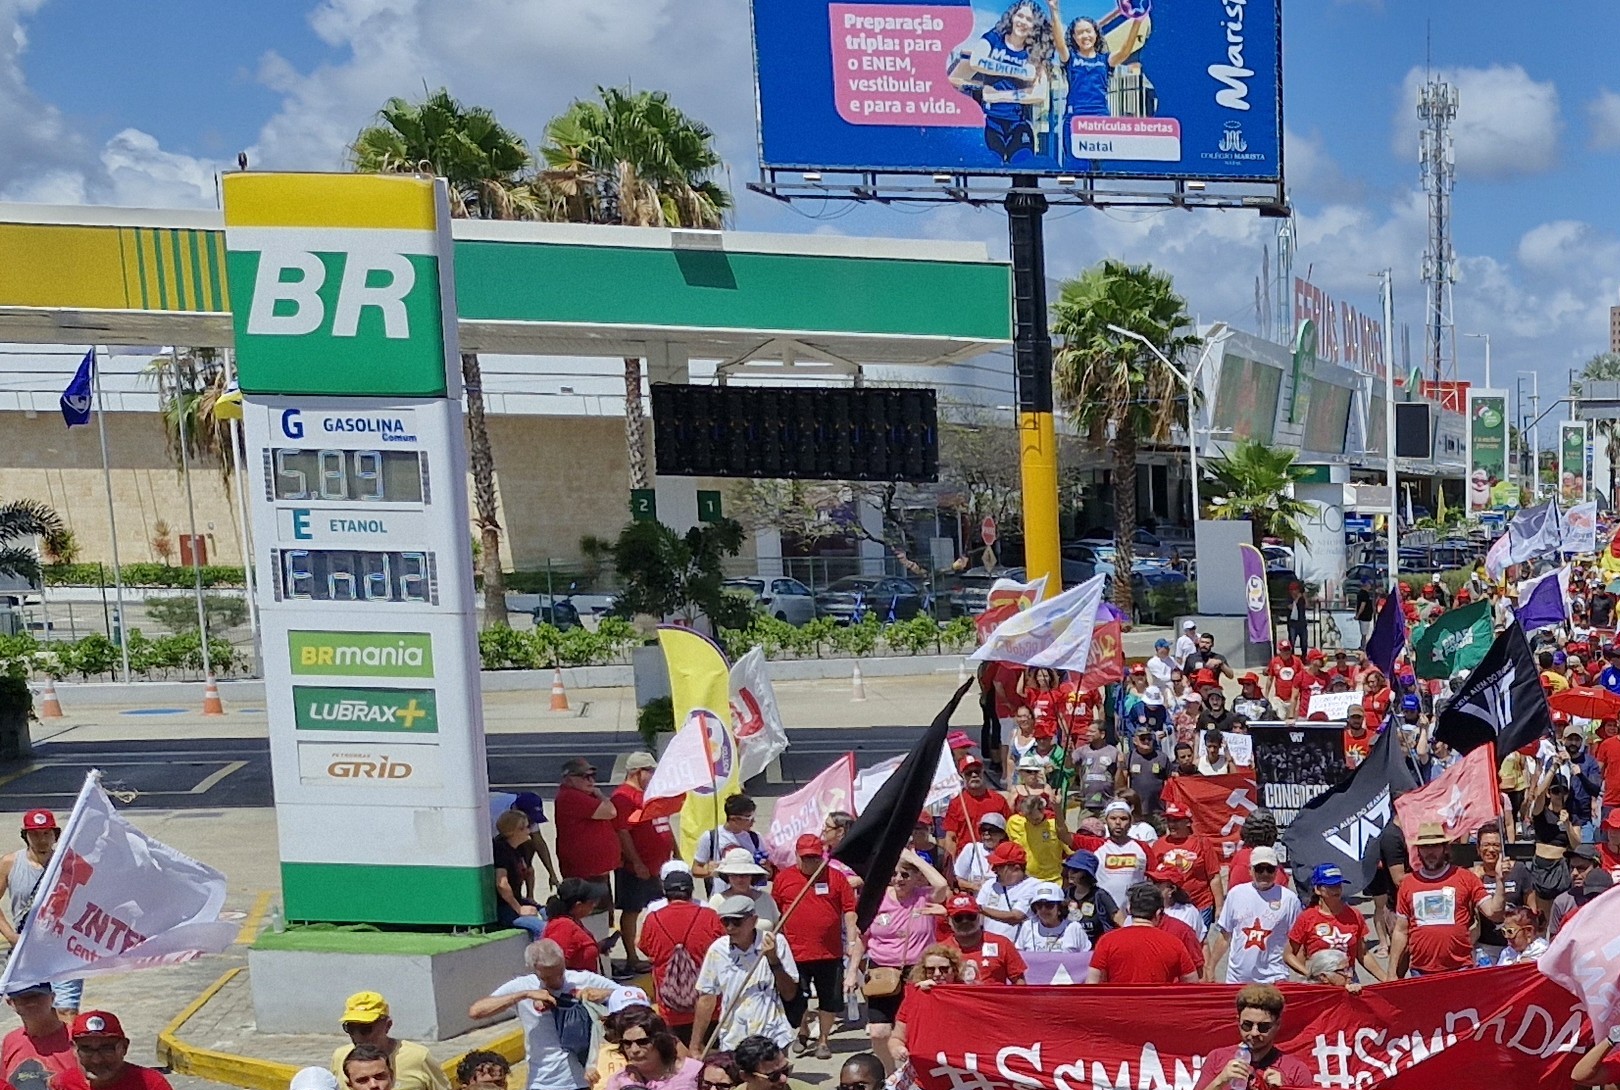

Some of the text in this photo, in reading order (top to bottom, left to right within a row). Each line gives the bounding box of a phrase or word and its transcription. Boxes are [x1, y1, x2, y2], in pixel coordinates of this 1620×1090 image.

[844, 14, 943, 33] Preparação
[846, 35, 942, 54] tripla: para
[848, 57, 916, 74] o ENEM,
[849, 77, 932, 92] vestibular
[850, 98, 961, 115] e para a vida.
[1078, 121, 1173, 133] Matrículas abertas
[1078, 141, 1113, 152] Natal
[246, 250, 416, 339] BR
[281, 408, 304, 439] G
[323, 418, 404, 433] GASOLINA
[382, 433, 417, 442] Comum
[639, 498, 649, 512] 2
[706, 500, 713, 512] 1
[292, 509, 313, 539] E
[330, 519, 388, 534] ETANOL
[301, 641, 423, 666] BRmania
[327, 756, 413, 779] GRID
[1108, 856, 1137, 868] CTB
[1249, 930, 1264, 941] PT
